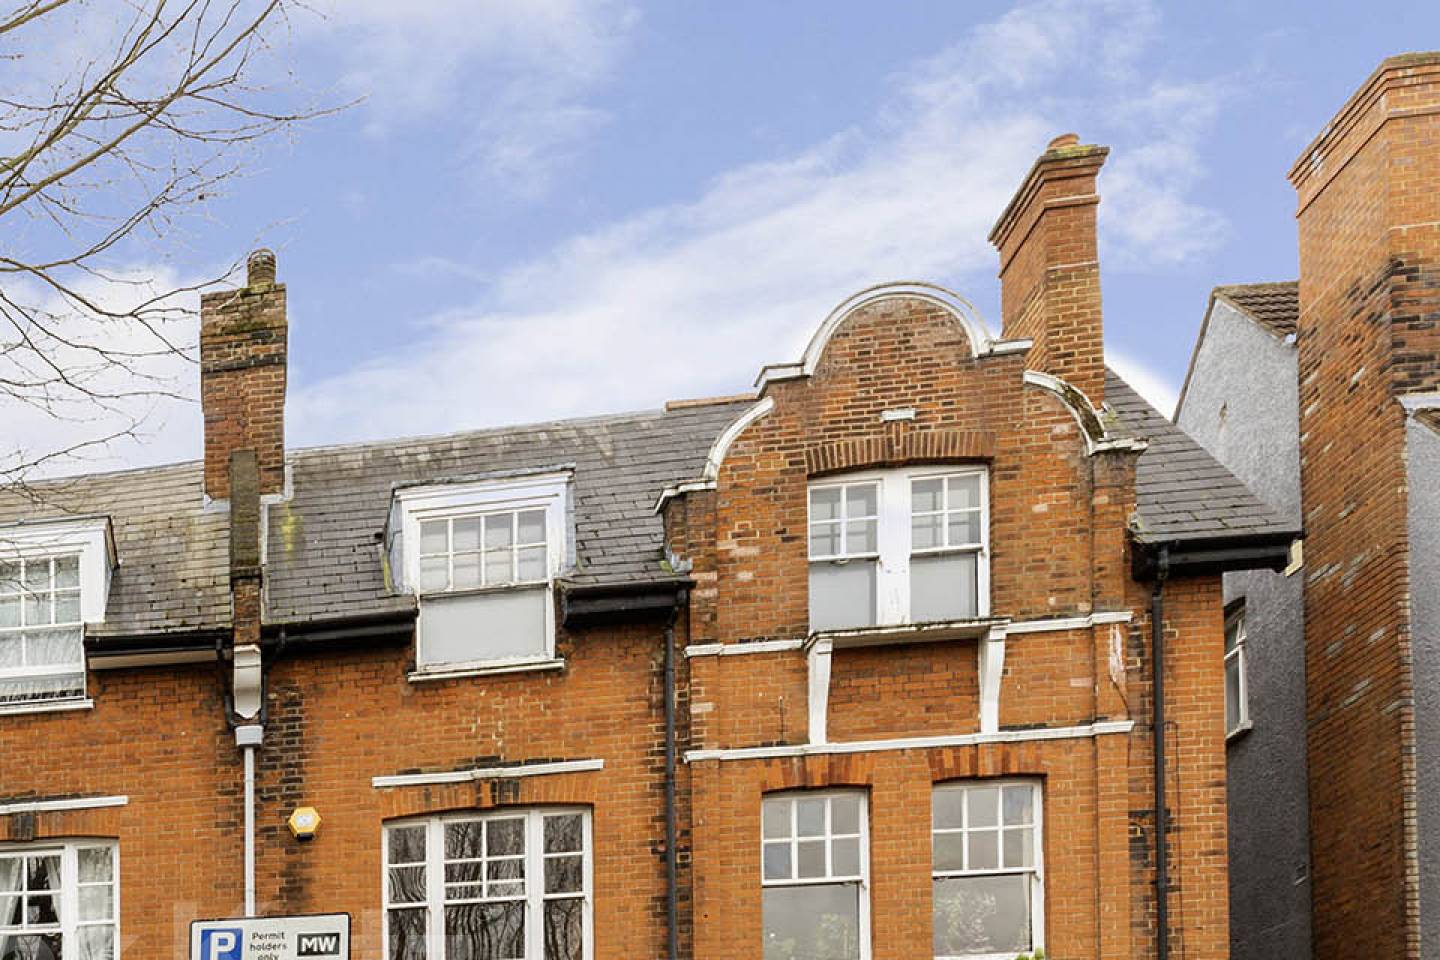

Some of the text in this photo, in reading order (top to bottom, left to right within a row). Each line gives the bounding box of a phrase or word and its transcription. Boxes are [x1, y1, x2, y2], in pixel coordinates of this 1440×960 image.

[251, 931, 285, 940] Permit
[250, 942, 288, 951] holders
[301, 936, 337, 952] MW
